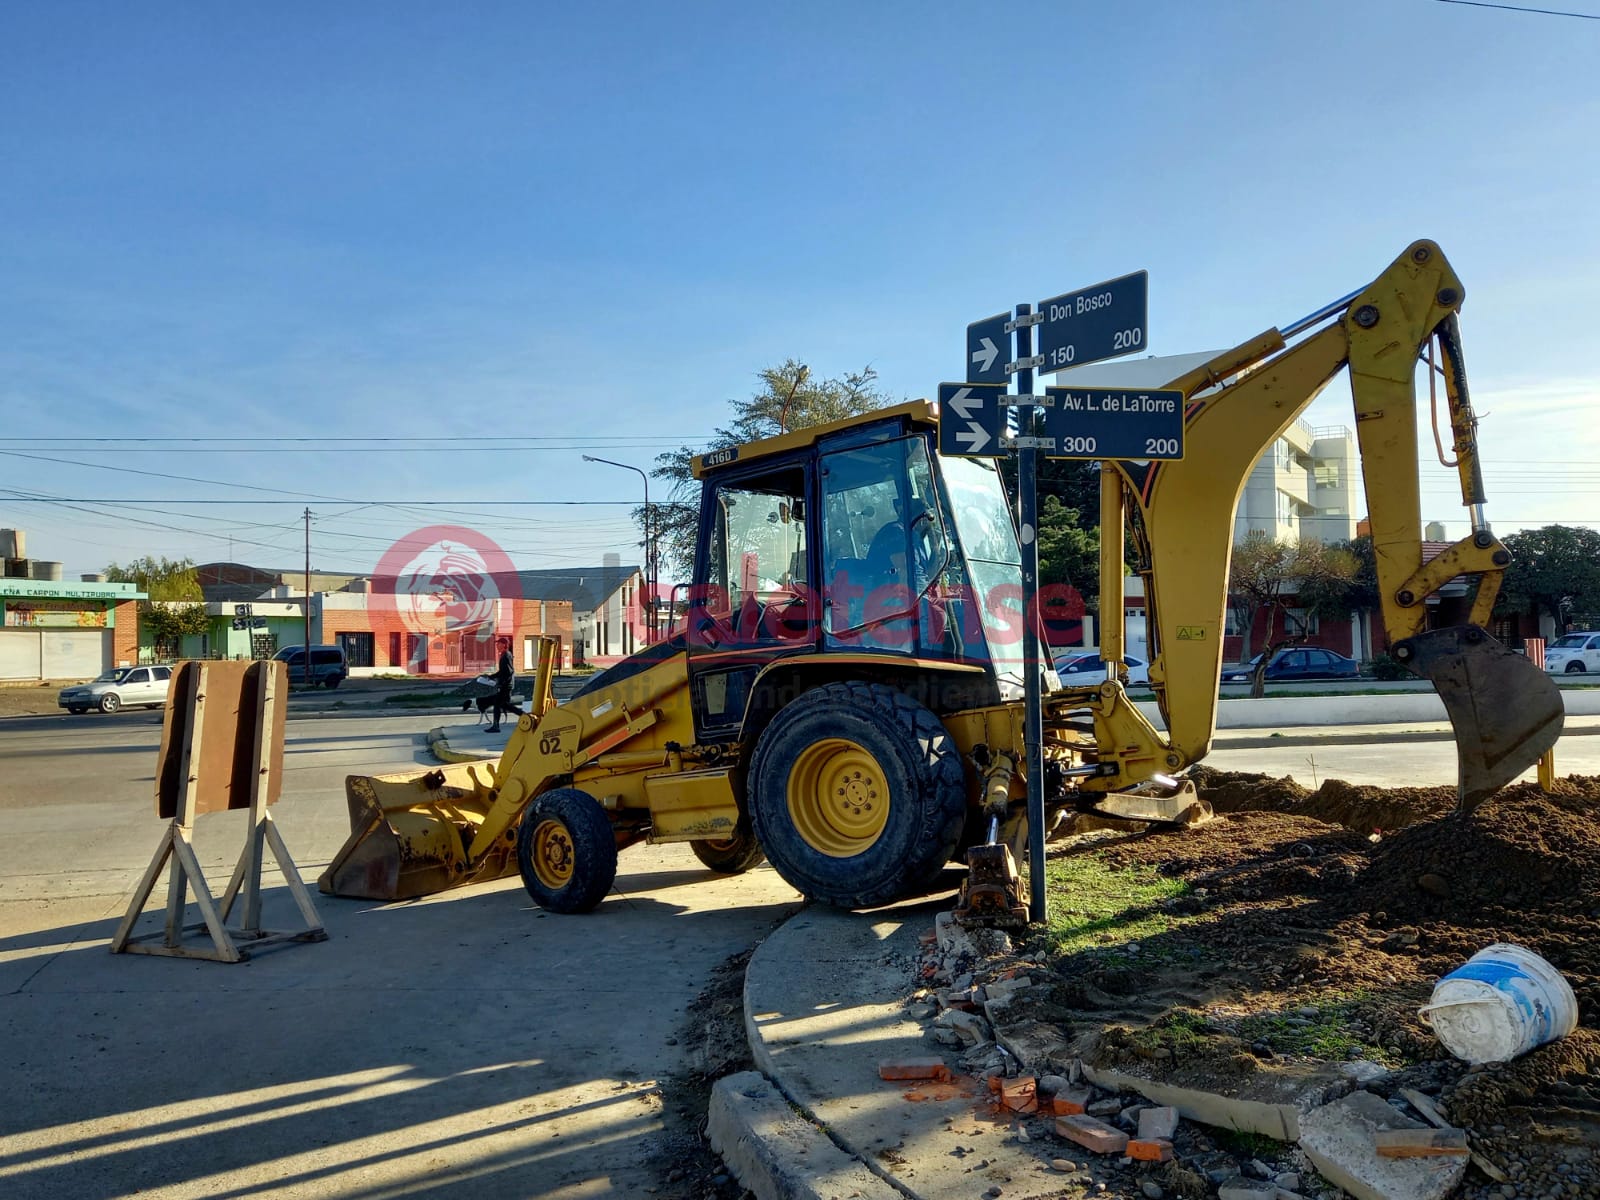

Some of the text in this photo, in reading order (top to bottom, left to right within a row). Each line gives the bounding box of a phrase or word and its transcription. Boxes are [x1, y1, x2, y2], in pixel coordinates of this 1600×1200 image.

[1050, 292, 1112, 322] Don Bosco
[1051, 327, 1141, 365] 150 200
[1063, 394, 1084, 411] Av.
[1087, 395, 1099, 411] L.
[1102, 395, 1120, 412] de
[1063, 437, 1178, 455] 300 200
[540, 737, 561, 755] 02
